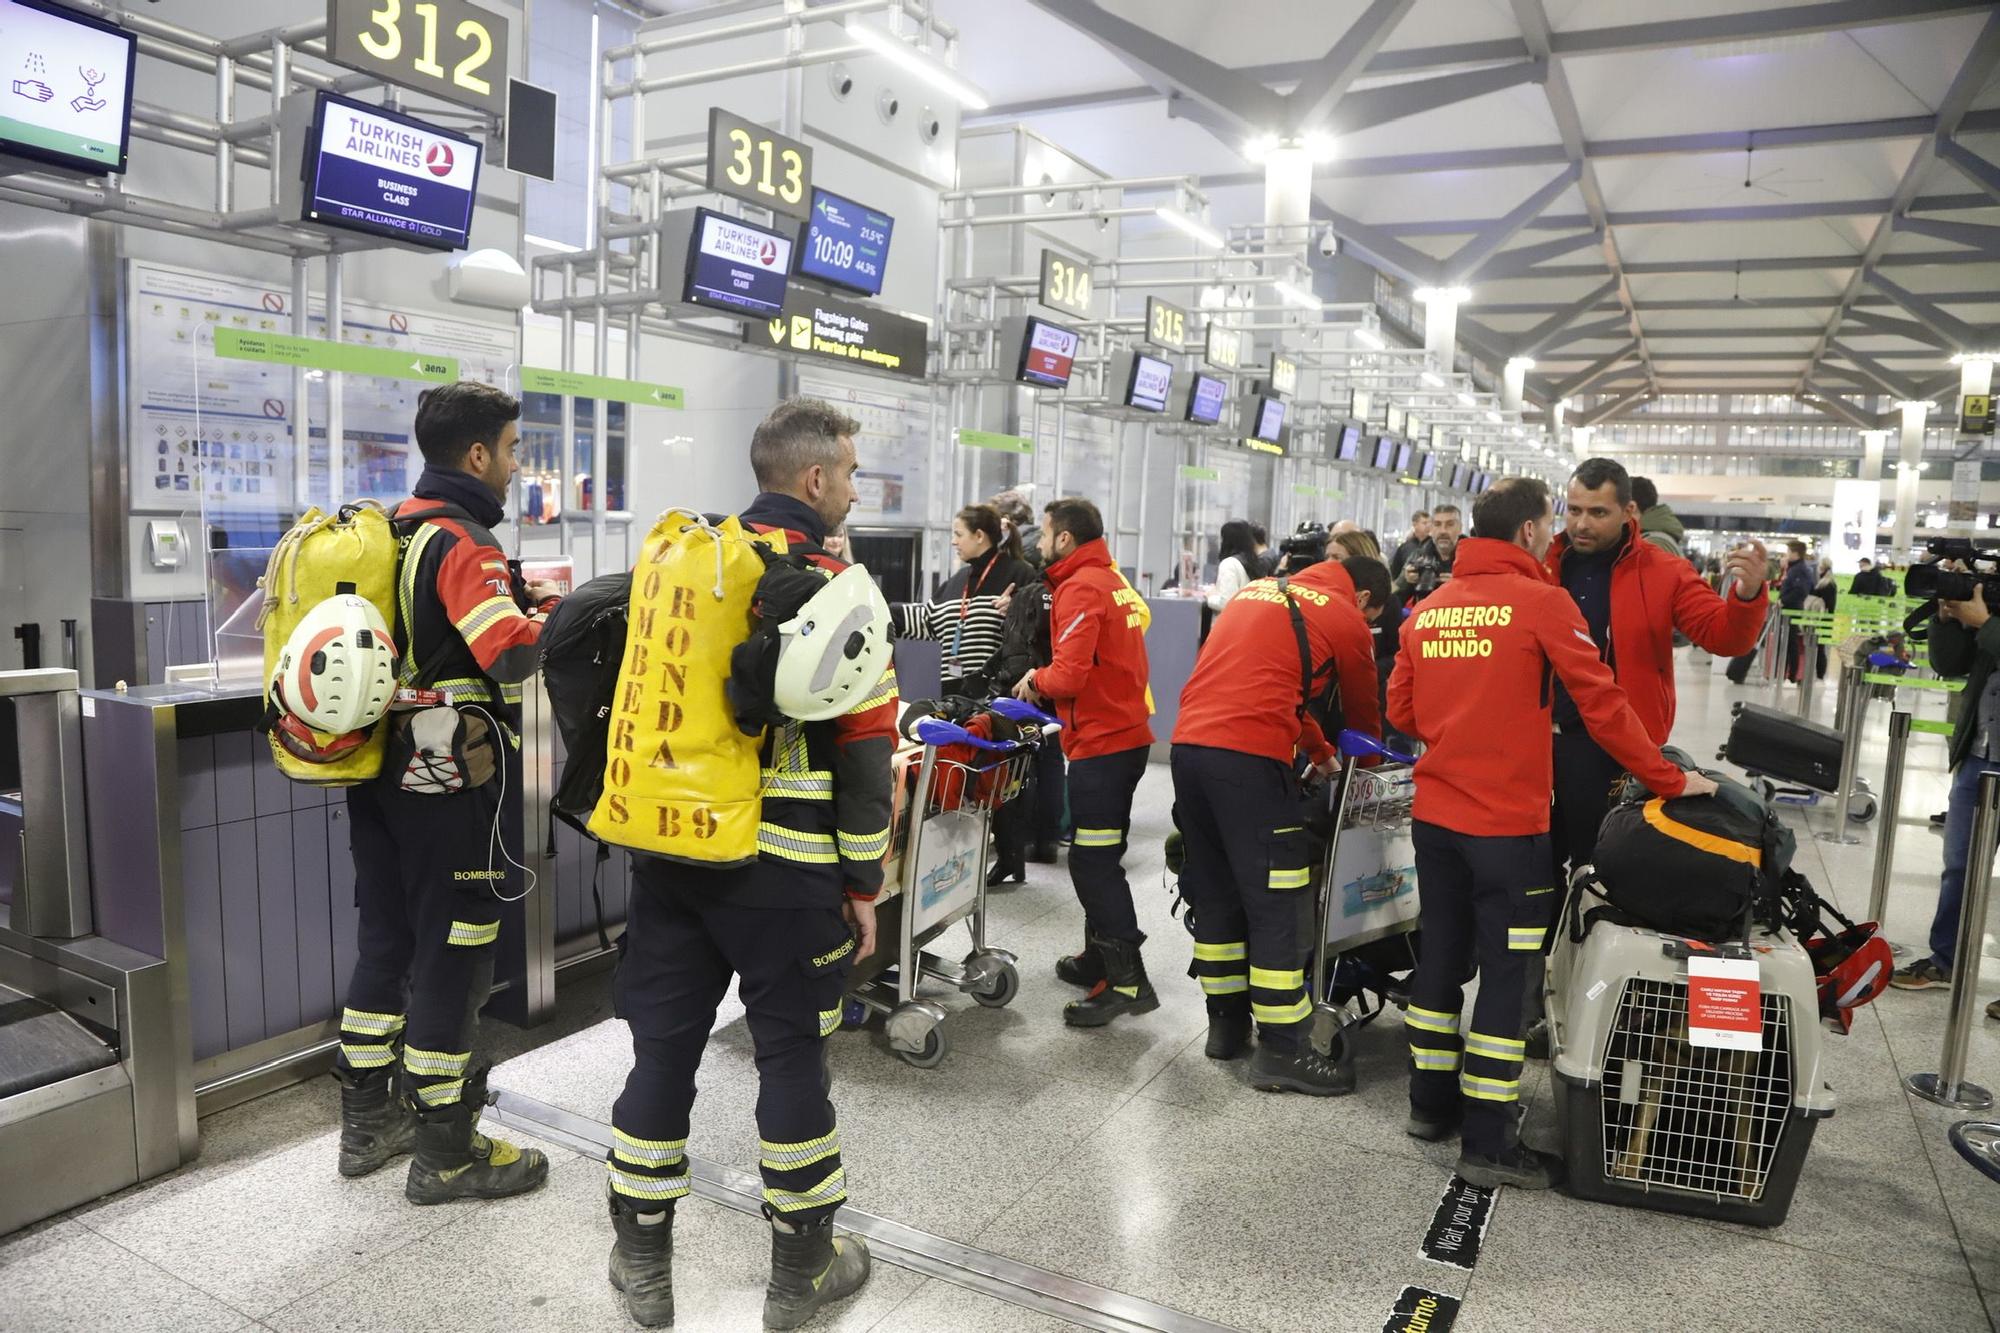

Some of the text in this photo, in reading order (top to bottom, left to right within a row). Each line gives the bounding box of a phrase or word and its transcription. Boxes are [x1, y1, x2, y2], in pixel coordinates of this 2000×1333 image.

[358, 0, 492, 96] 312
[349, 117, 423, 152] TURKISH
[346, 136, 421, 168] AIRLINES
[726, 128, 804, 204] 313
[377, 178, 418, 197] BUSINESS
[383, 192, 410, 207] CLASS
[341, 206, 442, 237] STAR ALLIANCE GOLD
[715, 239, 758, 260] AIRLINES
[718, 226, 759, 249] TURKISH
[814, 234, 854, 270] 10:09
[1050, 261, 1090, 311] 314
[814, 321, 864, 345] Boarding gates
[849, 316, 869, 333] Gates
[1153, 305, 1184, 347] 315
[813, 336, 847, 356] Puertas
[848, 344, 860, 359] de
[424, 362, 447, 375] aena
[1414, 605, 1513, 631] BOMBEROS
[1439, 629, 1478, 639] PARA EL
[1422, 639, 1494, 659] MUNDO
[648, 585, 698, 769] RONDA
[454, 870, 506, 881] BOMBEROS
[812, 939, 855, 968] BOMBERO
[1435, 1227, 1465, 1251] Wait
[1450, 1203, 1473, 1230] your
